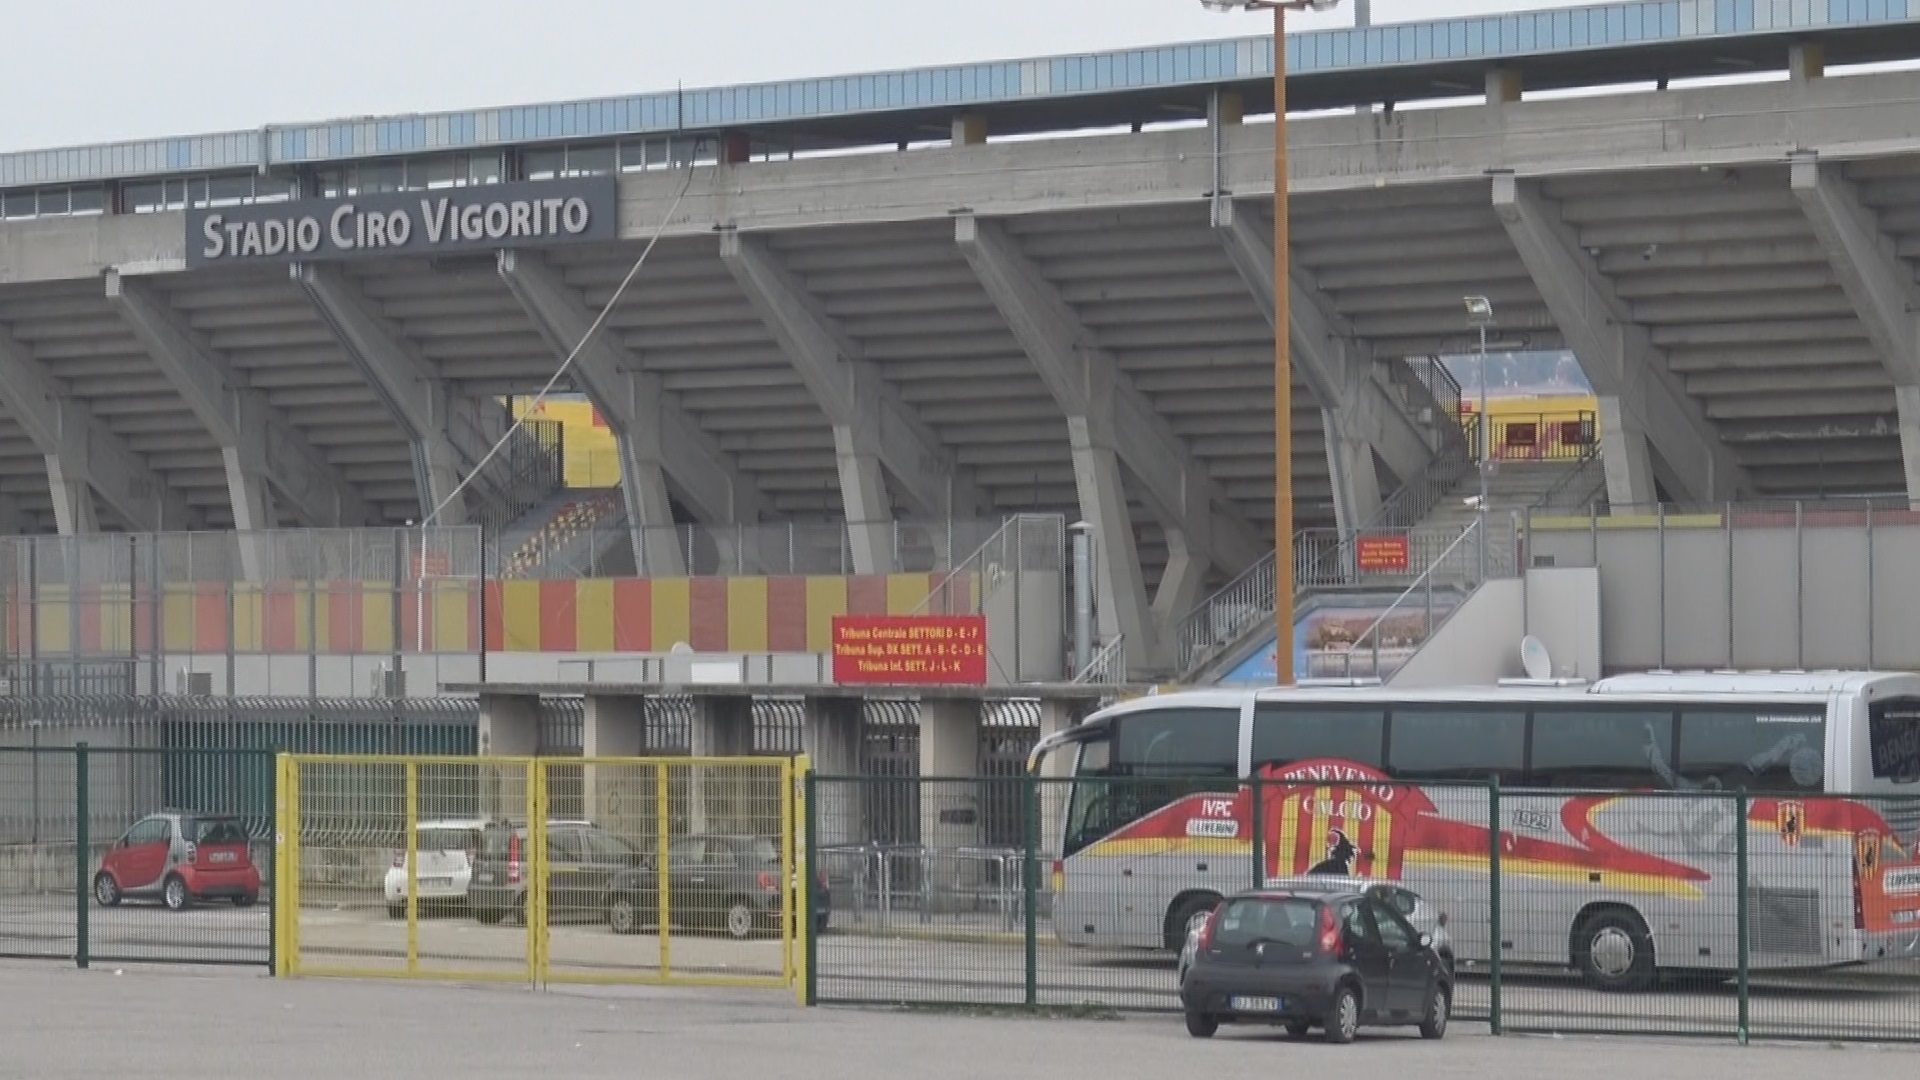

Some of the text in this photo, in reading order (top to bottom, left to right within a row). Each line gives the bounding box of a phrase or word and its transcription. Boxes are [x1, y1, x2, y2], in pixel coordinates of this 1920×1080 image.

[203, 197, 589, 259] STADIO CIRO VIGORITO
[840, 627, 871, 639] Tribuna
[872, 627, 907, 639] Centrale
[908, 627, 945, 638] SETTORI
[946, 627, 953, 638] D
[959, 627, 966, 638] E
[972, 627, 978, 638] F
[835, 643, 866, 656] Tribuna
[867, 643, 885, 658] Sup.
[886, 643, 899, 656] DX
[900, 643, 922, 656] SETT.
[924, 643, 932, 655] A
[937, 643, 944, 655] B
[951, 643, 957, 655] C
[964, 643, 971, 655] D
[977, 643, 984, 656] E
[857, 659, 888, 671] Tribuna
[905, 660, 927, 672] SETT.
[929, 660, 935, 672] J
[941, 660, 947, 672] L
[953, 660, 961, 672] K
[1284, 765, 1394, 802] BENEVENTO
[1202, 800, 1233, 817] IVPC
[1303, 794, 1371, 821] CALCIO
